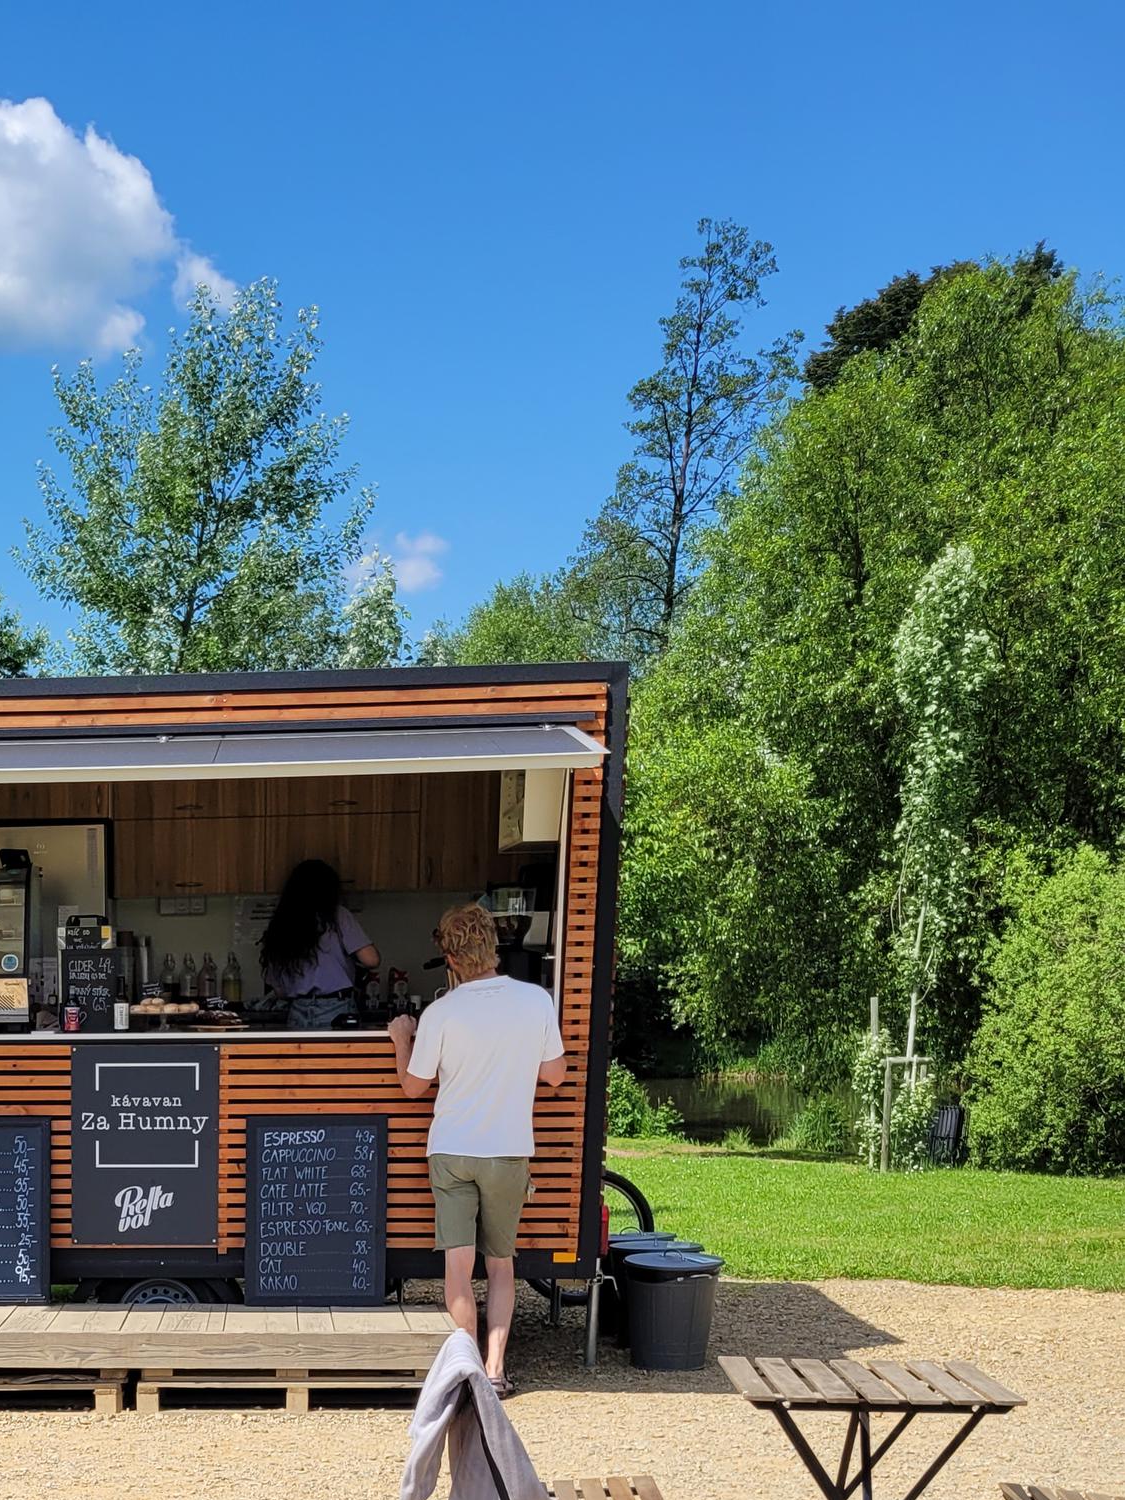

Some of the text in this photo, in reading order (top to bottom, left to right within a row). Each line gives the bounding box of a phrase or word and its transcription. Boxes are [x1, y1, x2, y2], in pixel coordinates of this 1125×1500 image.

[68, 960, 96, 972] CIDER
[110, 1094, 182, 1107] kávavan
[81, 1112, 209, 1134] Za Humny
[264, 1129, 326, 1148] ESPRESSO
[262, 1148, 336, 1164] CAPPUCCINO
[262, 1166, 288, 1180] FLAT
[294, 1166, 328, 1180] WHITE
[260, 1184, 288, 1199] CAFE
[294, 1183, 328, 1198] LATTE
[261, 1202, 294, 1218] FILTR
[260, 1242, 306, 1256] DOUBLE
[260, 1275, 298, 1290] KAKAO
